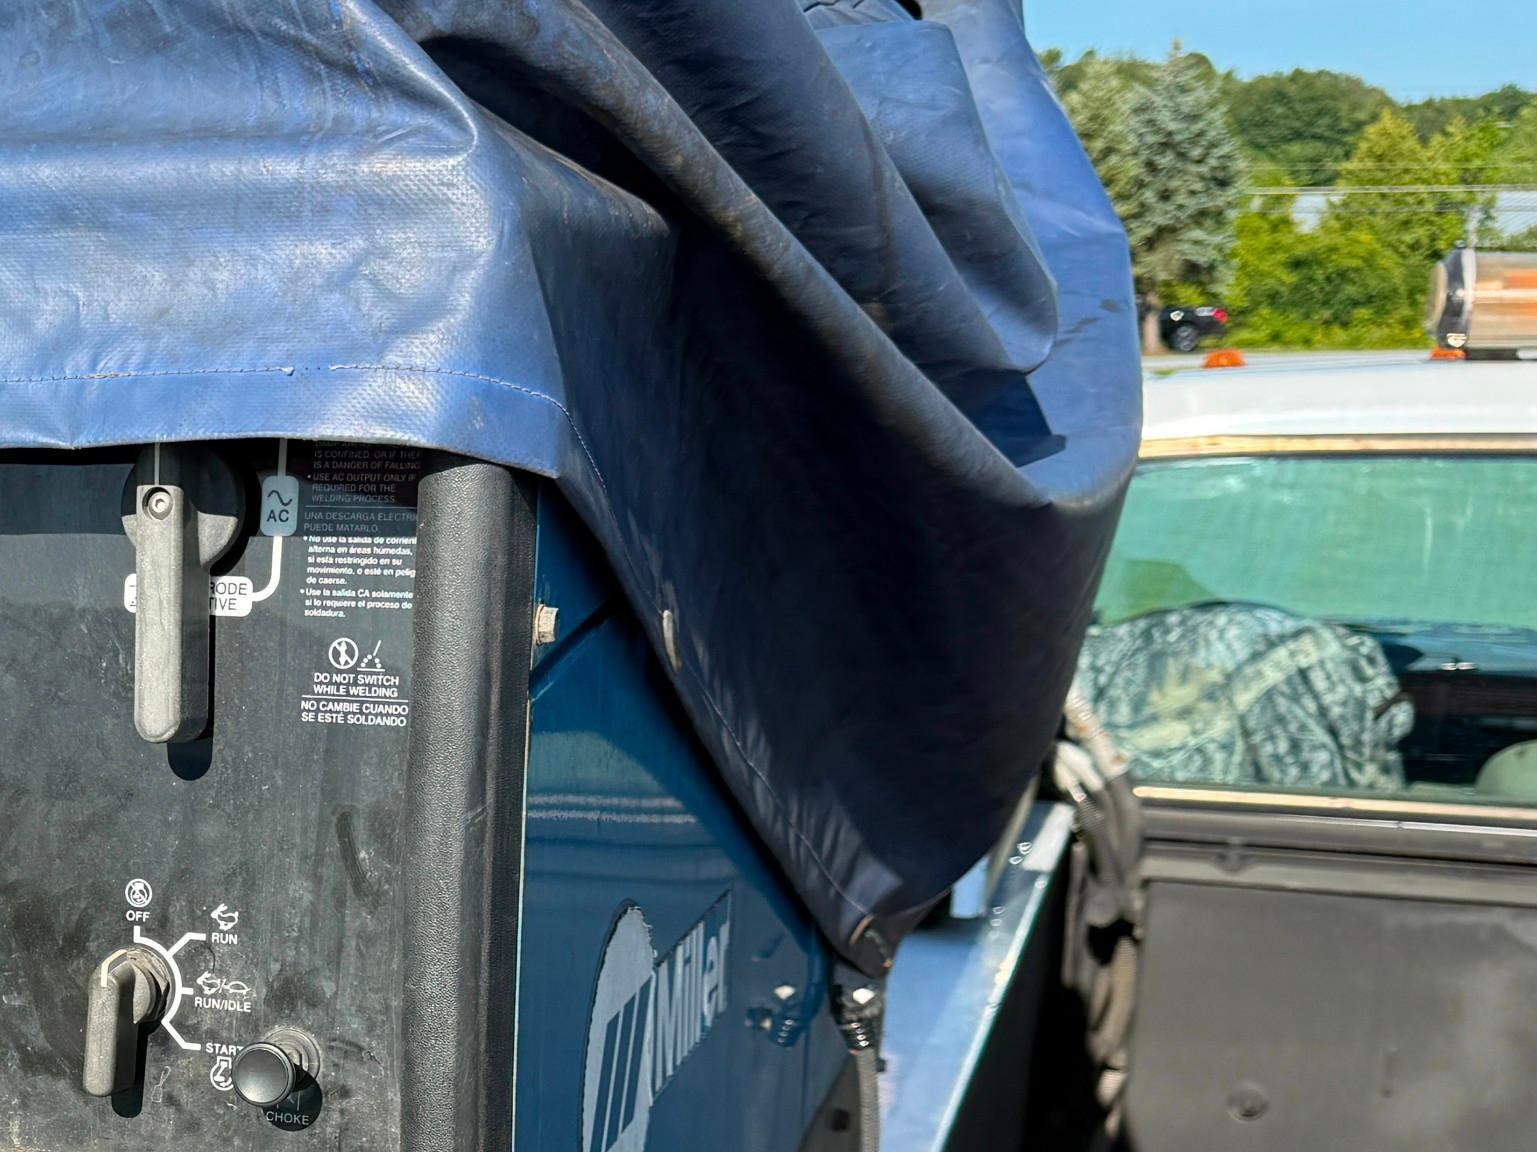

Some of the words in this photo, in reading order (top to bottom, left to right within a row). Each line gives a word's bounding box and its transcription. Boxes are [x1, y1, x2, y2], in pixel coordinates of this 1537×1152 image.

[312, 473, 331, 481] USE
[332, 473, 345, 481] AC
[346, 474, 381, 482] OUTPUT
[312, 483, 357, 493] REQUIRED
[358, 484, 378, 494] FOR
[379, 484, 396, 493] THE
[312, 494, 352, 503] WELDING
[266, 509, 290, 523] AC
[304, 511, 324, 520] UNA
[326, 512, 375, 521] DESCARGA
[304, 522, 333, 531] PUEDE
[373, 536, 384, 544] de
[335, 556, 378, 566] restringido
[306, 576, 317, 584] de
[306, 588, 321, 596] Use
[357, 589, 370, 597] CA
[371, 590, 413, 599] solamente
[323, 600, 356, 608] requiere
[401, 601, 412, 609] de
[314, 672, 330, 683] DO
[332, 673, 355, 684] NOT
[357, 674, 399, 686] SWITCH
[313, 684, 346, 695] WHILE
[349, 686, 398, 698] WELDING
[301, 700, 317, 711] NO
[319, 702, 360, 713] CAMBIE
[362, 703, 408, 715] CUANDO
[301, 712, 315, 722] SE
[347, 715, 406, 727] SOLDANDO
[125, 910, 150, 923] OFF
[211, 932, 238, 945] RUN
[194, 996, 252, 1013] RUN/IDLE
[265, 1110, 310, 1125] CHOKE
